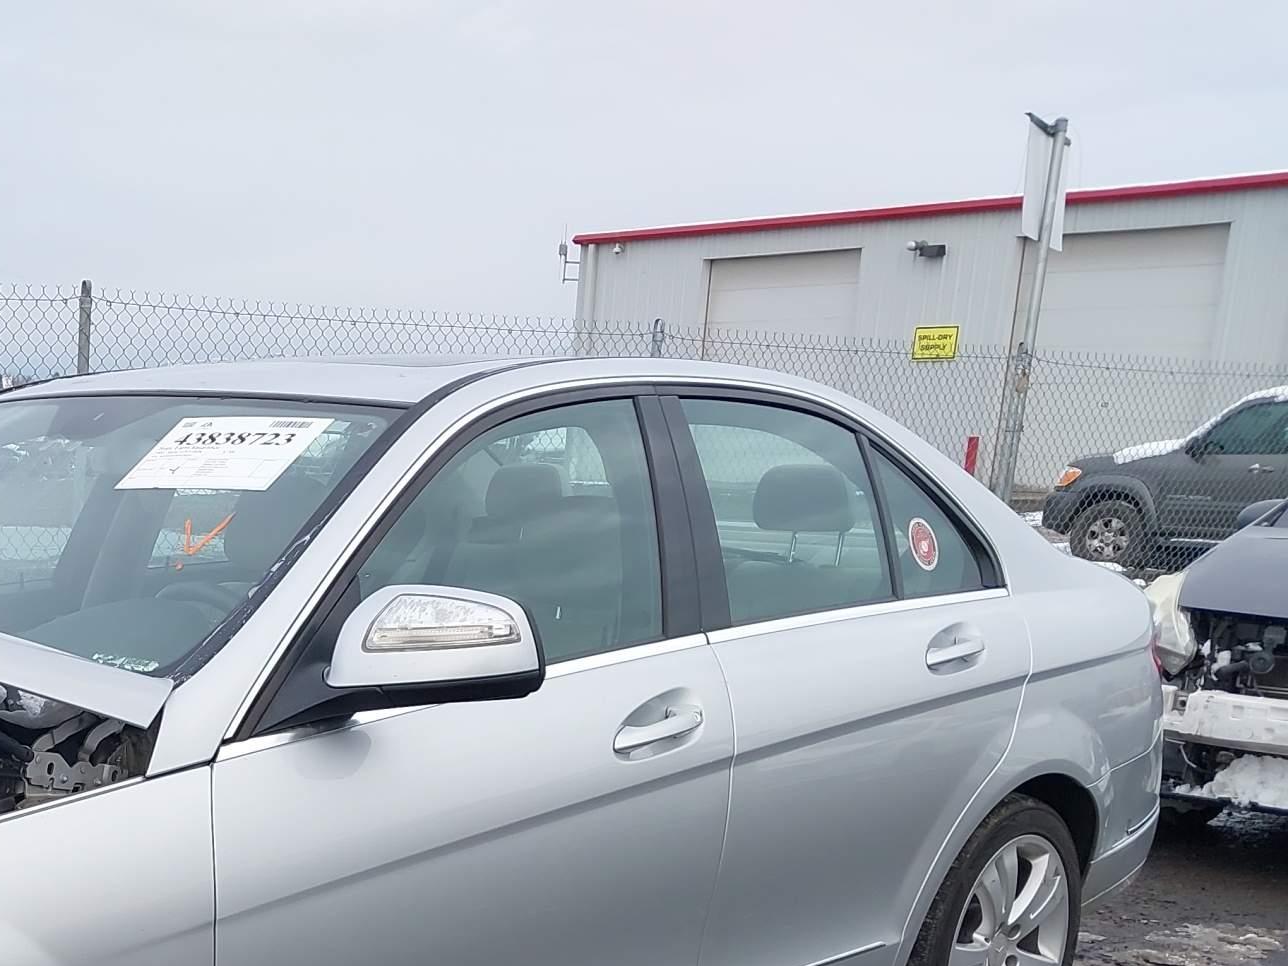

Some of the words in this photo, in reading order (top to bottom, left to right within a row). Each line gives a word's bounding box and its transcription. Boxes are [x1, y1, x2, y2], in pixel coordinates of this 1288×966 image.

[918, 333, 953, 341] SPILL-DRY
[920, 343, 947, 351] SUPPLY
[174, 431, 297, 446] 43838723
